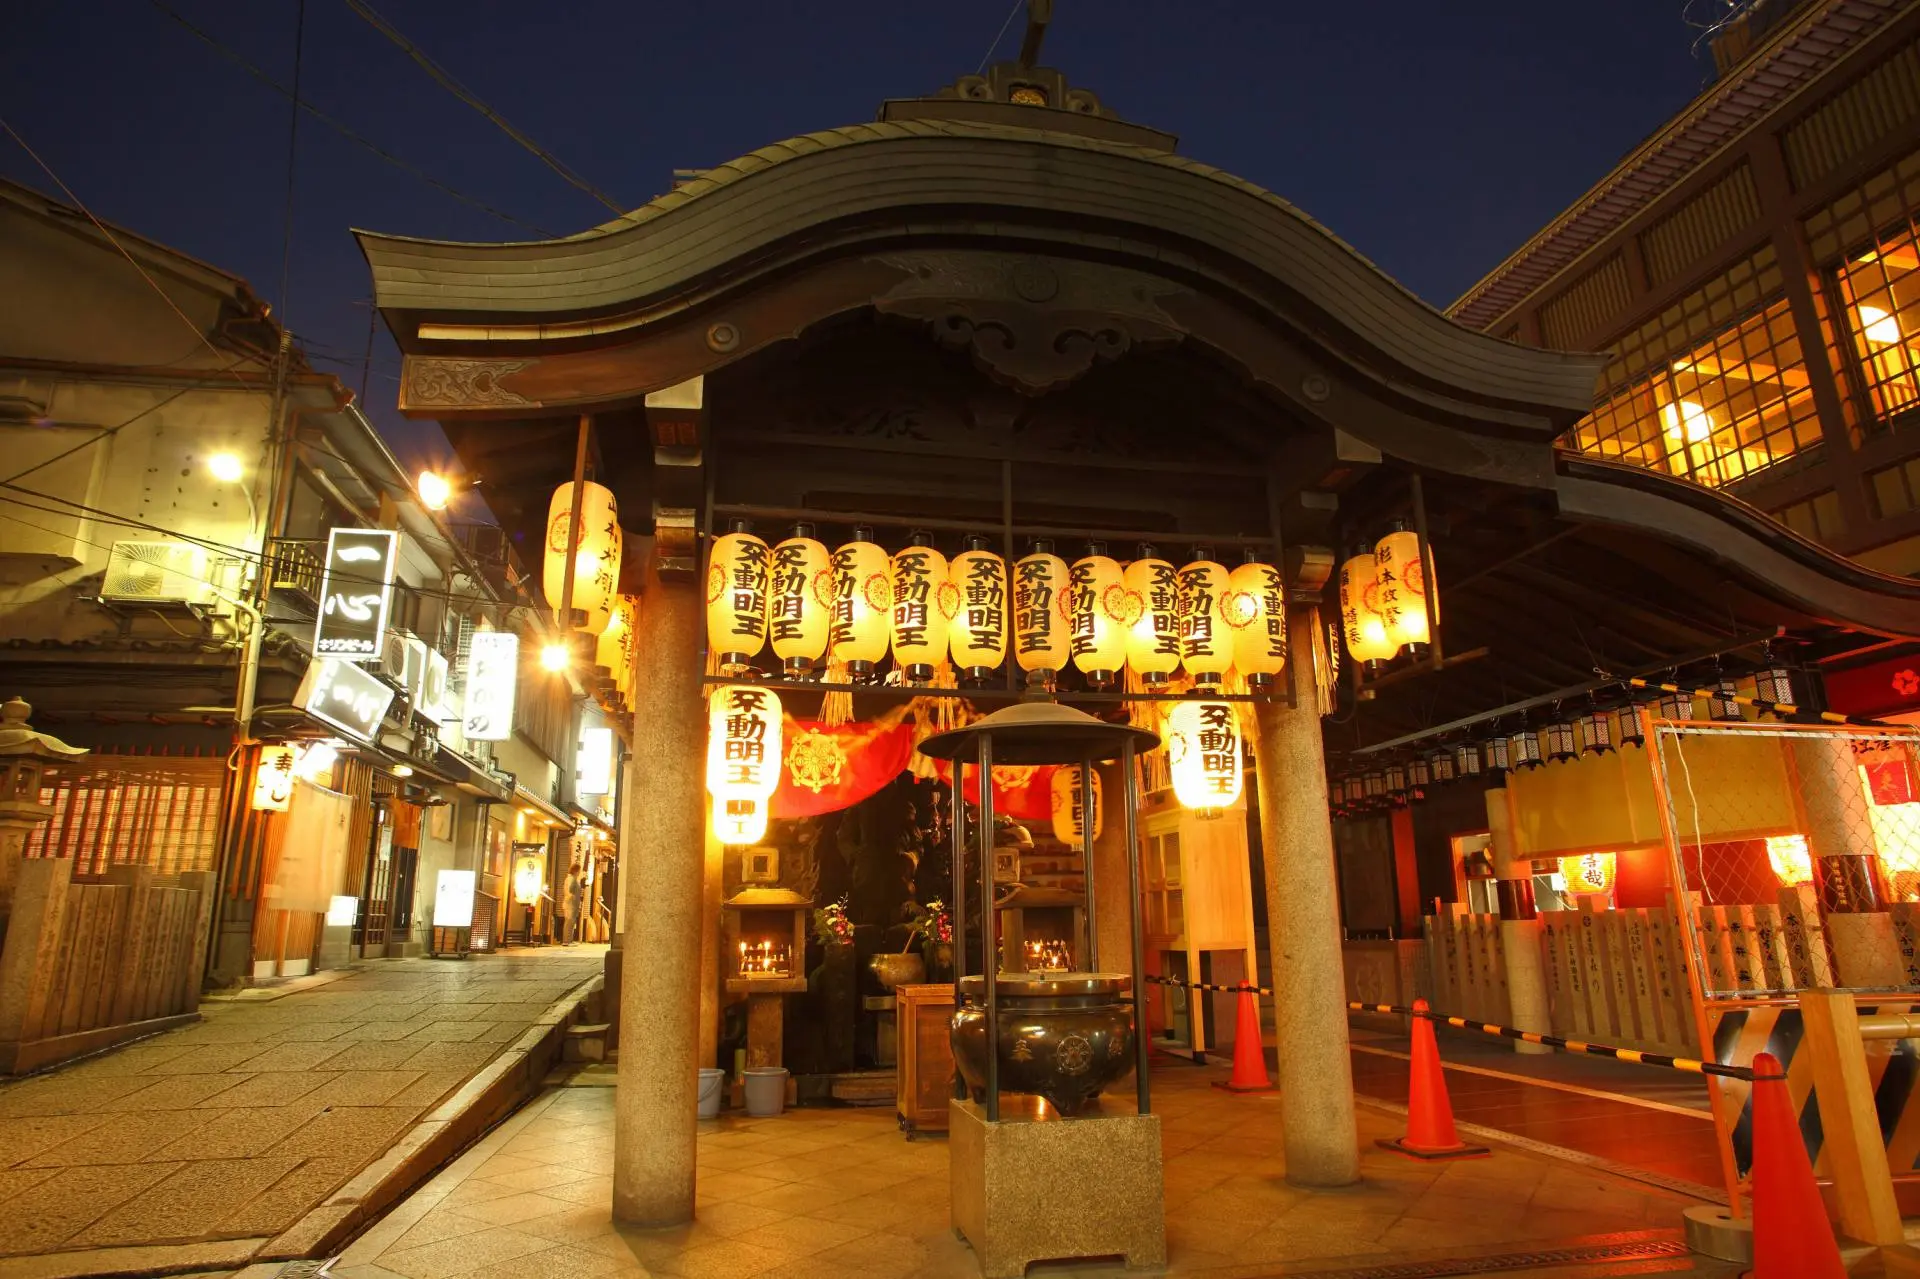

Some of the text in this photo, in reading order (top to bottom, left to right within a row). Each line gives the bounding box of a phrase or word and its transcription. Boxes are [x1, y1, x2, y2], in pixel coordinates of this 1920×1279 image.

[732, 540, 769, 639] 不動明王
[771, 544, 808, 642] 不動明王
[831, 548, 857, 645] 不動明王
[893, 553, 931, 648] 不動明王
[966, 557, 1004, 651] 不動明王
[1016, 560, 1053, 652] 不動明王
[1070, 563, 1096, 656] 不動明王
[1149, 564, 1180, 655] 不動明王
[1179, 567, 1214, 657] 不動明王
[724, 690, 767, 785] 不動明王
[1199, 705, 1236, 796] 不動明王
